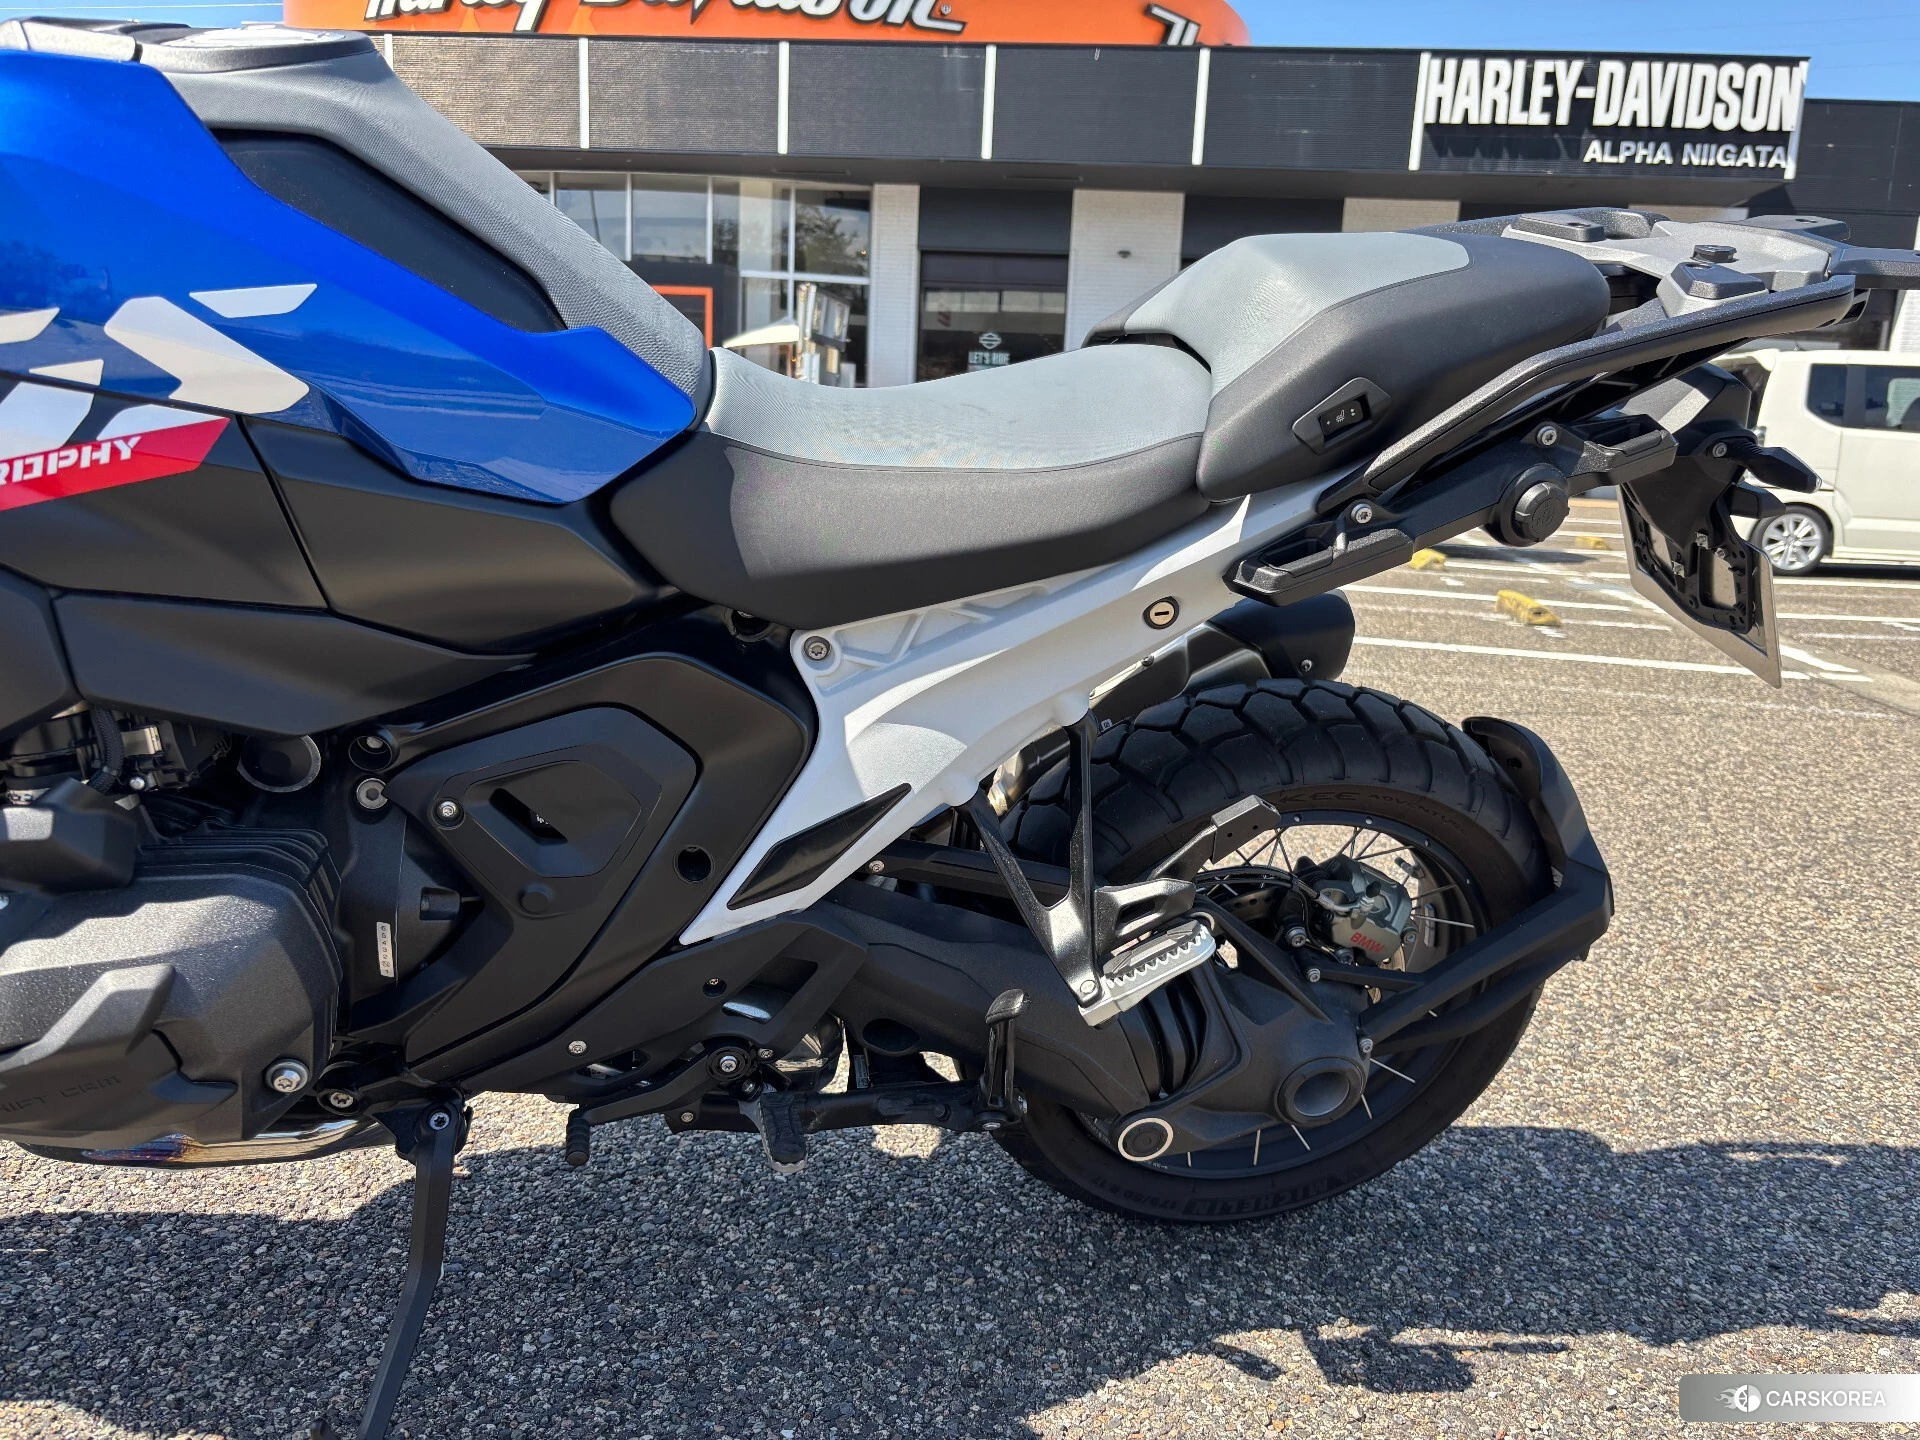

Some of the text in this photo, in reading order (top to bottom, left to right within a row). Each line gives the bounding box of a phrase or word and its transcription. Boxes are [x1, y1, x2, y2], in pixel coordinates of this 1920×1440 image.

[1424, 57, 1801, 133] HARLEY-DAVIDSON
[1583, 139, 1787, 169] ALPHA NIIGATA
[968, 352, 990, 364] LET'S
[1350, 932, 1385, 954] BMW
[1191, 1178, 1329, 1215] MICHELIN
